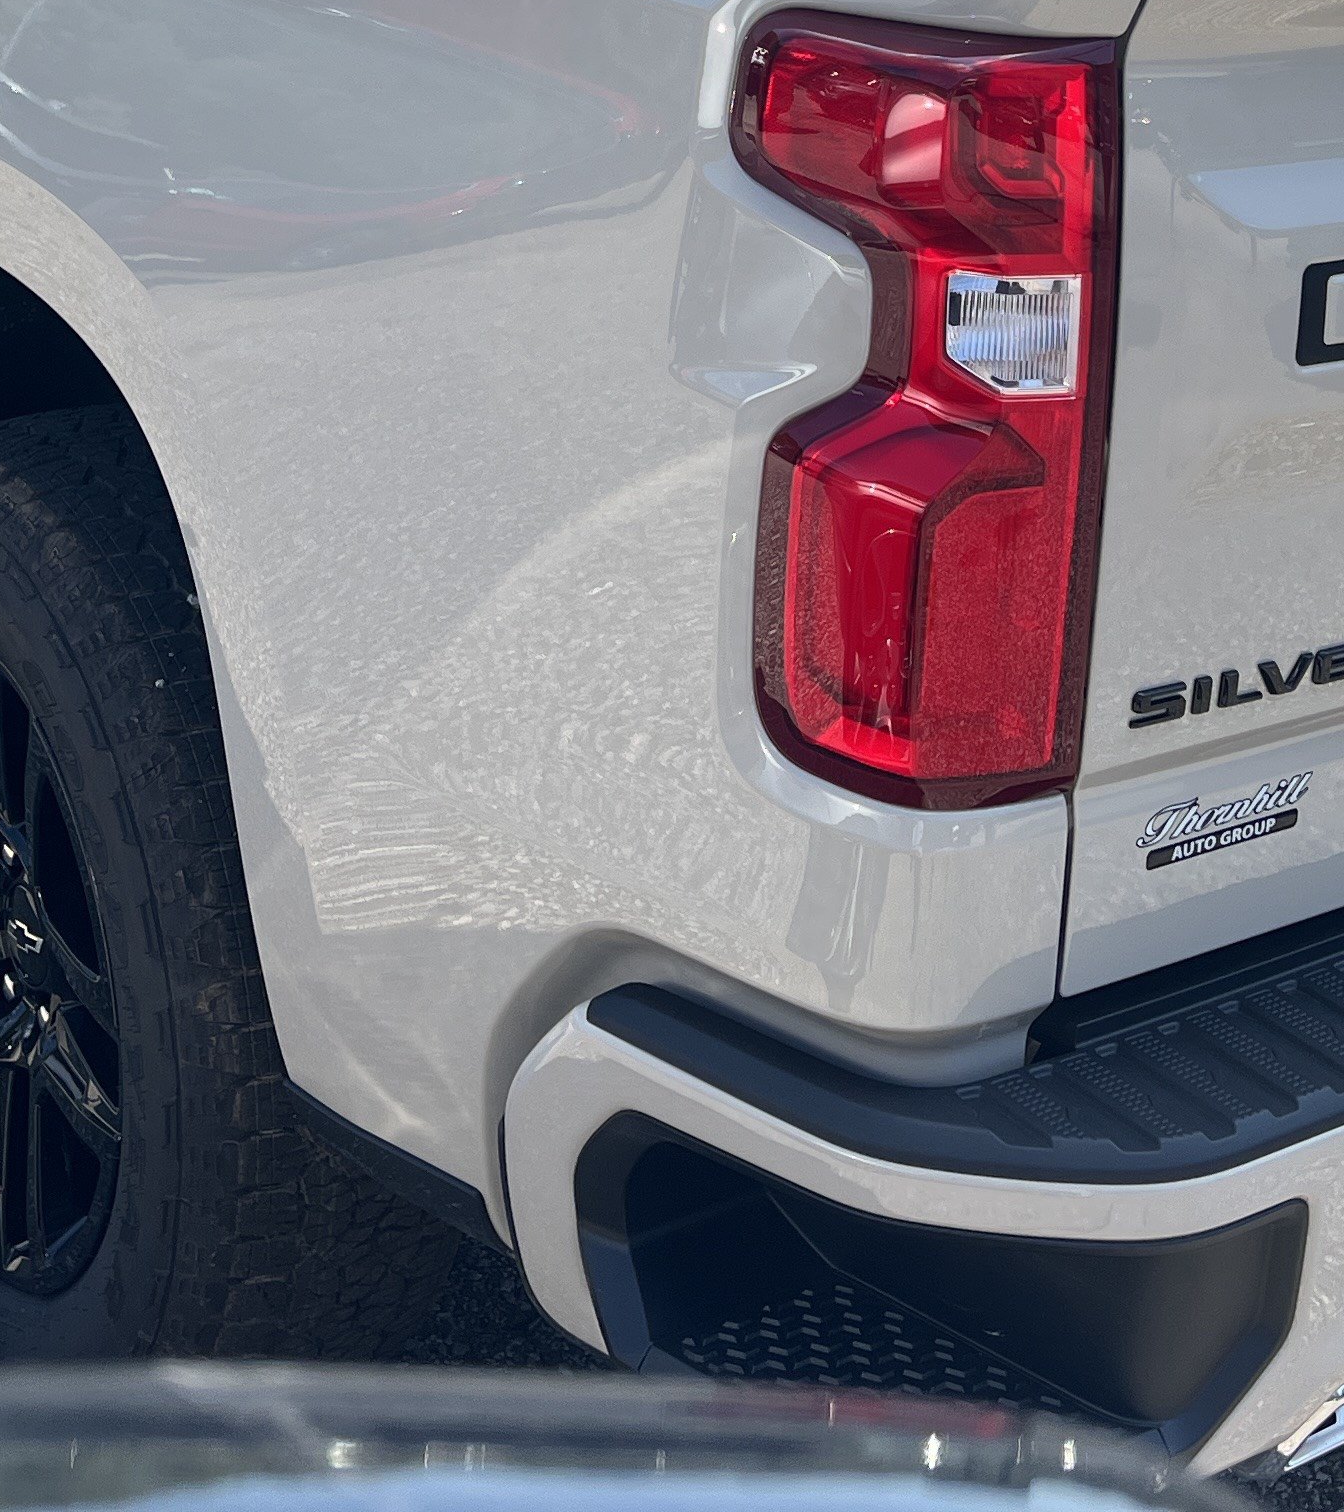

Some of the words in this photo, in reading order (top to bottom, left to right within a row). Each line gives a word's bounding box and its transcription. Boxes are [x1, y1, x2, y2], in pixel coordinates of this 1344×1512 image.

[1135, 770, 1314, 850] Thornhill
[1172, 831, 1218, 861] AUTO
[1221, 817, 1277, 847] GROUP
